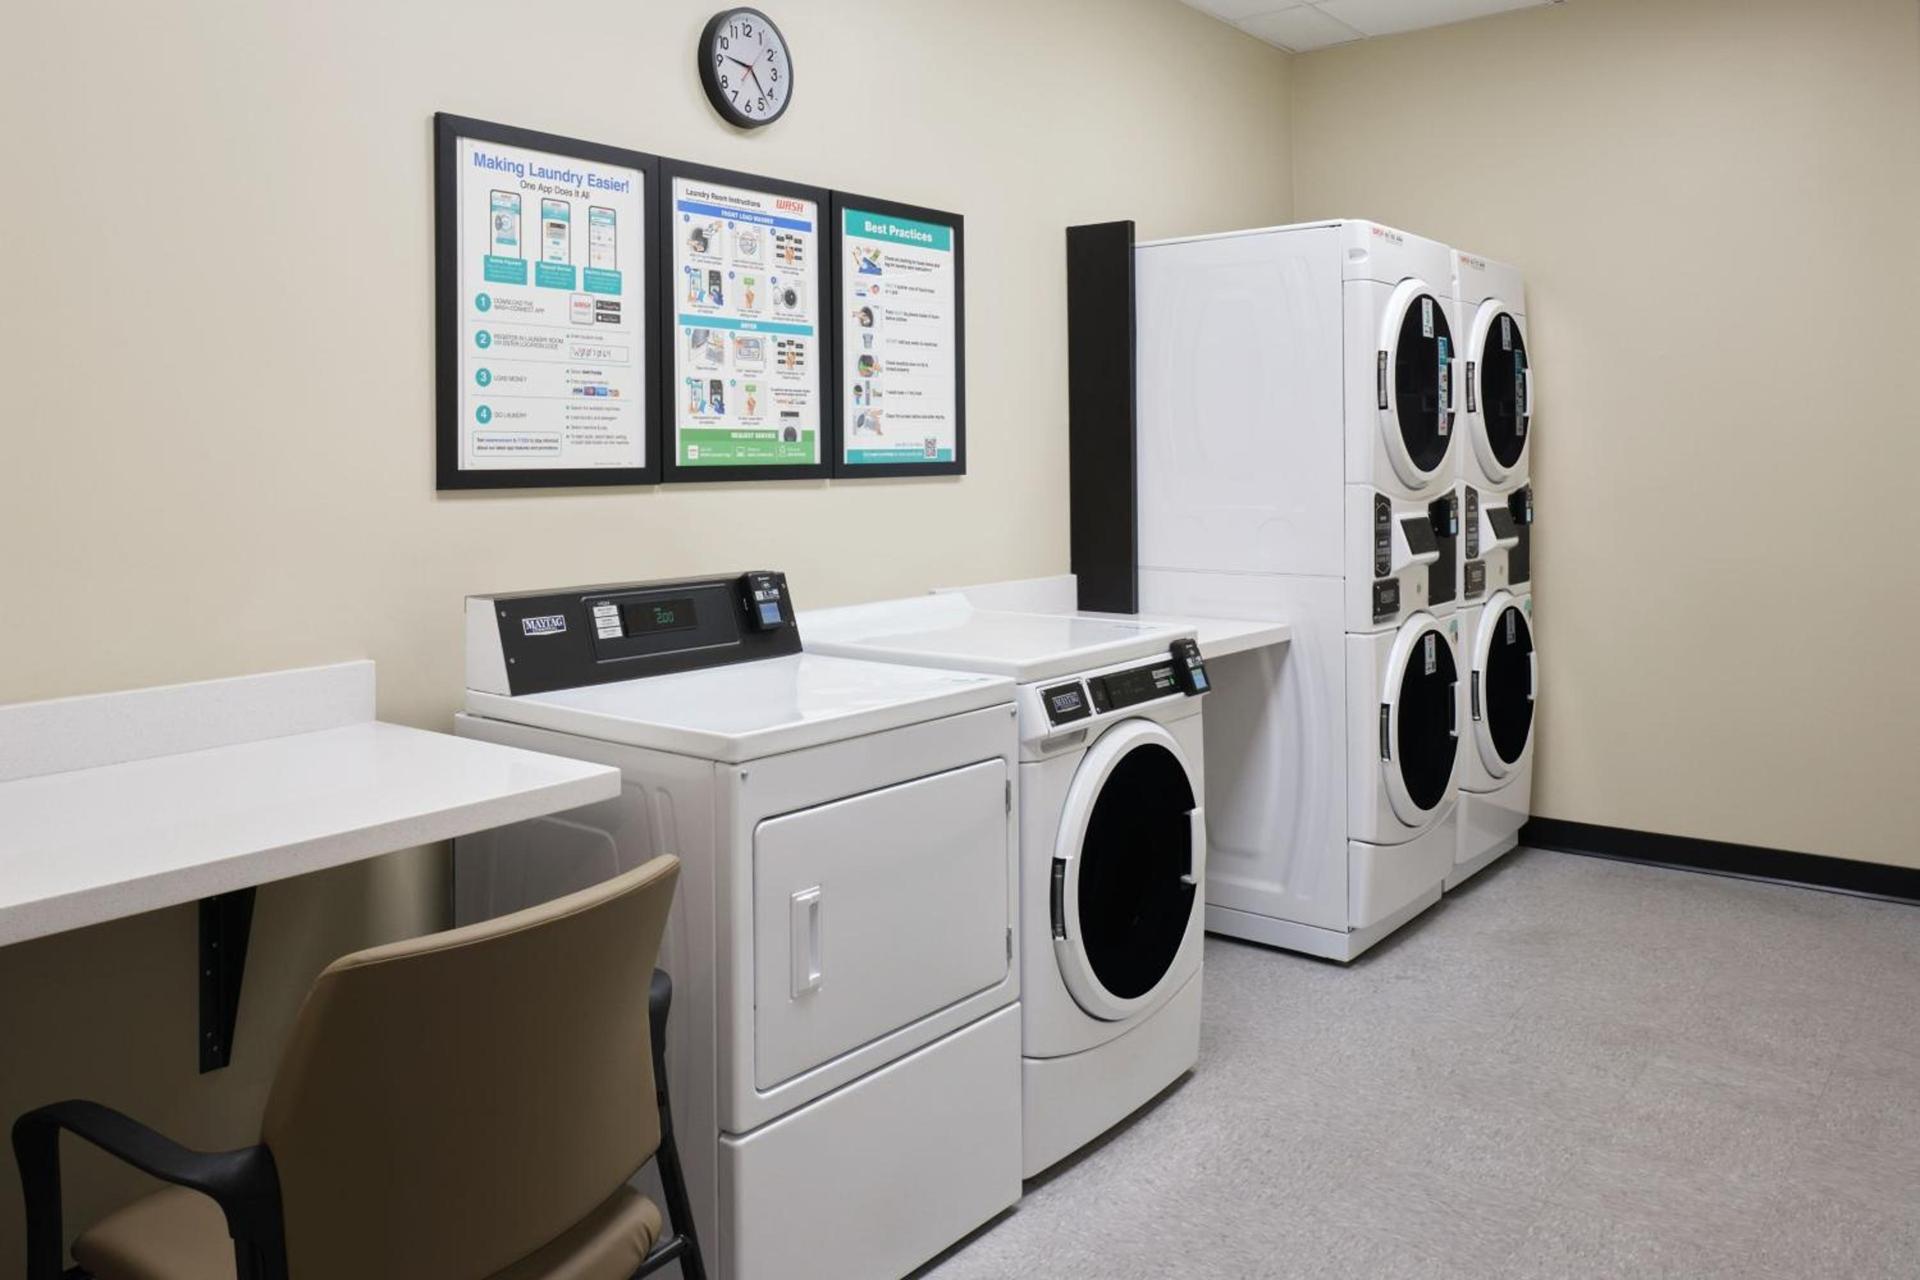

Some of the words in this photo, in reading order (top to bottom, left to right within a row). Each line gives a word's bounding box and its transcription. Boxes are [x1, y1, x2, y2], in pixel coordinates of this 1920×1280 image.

[730, 24, 738, 39] 11
[742, 22, 752, 38] 12
[719, 35, 729, 50] 10
[759, 32, 763, 46] 1
[716, 53, 723, 67] 9
[766, 48, 774, 62] 2
[721, 74, 729, 89] 8
[770, 67, 778, 82] 3
[731, 89, 739, 103] 7
[767, 87, 774, 101] 4
[744, 99, 752, 113] 6
[757, 97, 765, 111] 5
[473, 152, 525, 178] Making
[529, 163, 583, 188] Laundry
[587, 174, 630, 194] Easier!
[520, 180, 536, 191] One
[537, 182, 553, 195] App
[555, 185, 573, 197] Does
[574, 187, 580, 198] It
[581, 189, 590, 199] All
[686, 188, 710, 200] Laundry
[711, 193, 728, 202] Room
[728, 195, 761, 208] Instructions
[776, 199, 804, 212] WASH
[864, 220, 887, 235] Best
[889, 225, 933, 243] Practices
[480, 409, 487, 419] 4
[526, 617, 562, 630] MAYTAG
